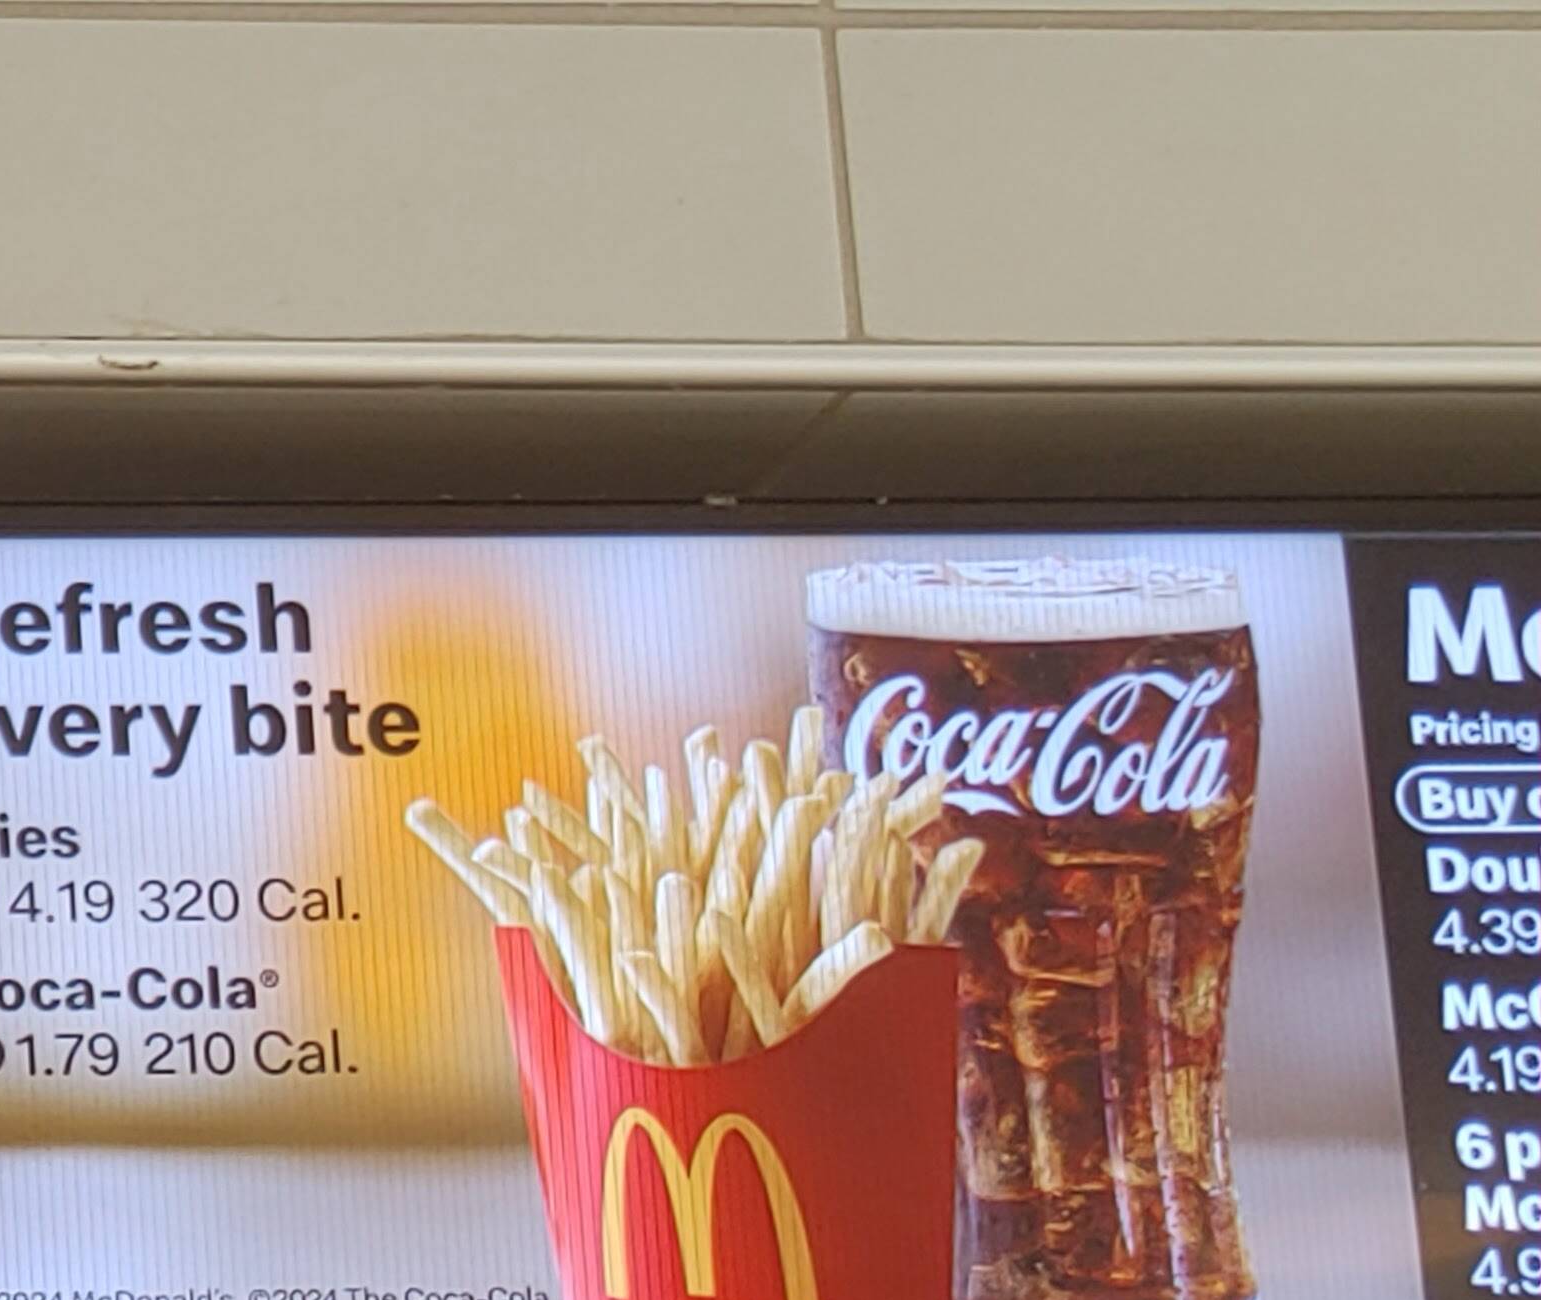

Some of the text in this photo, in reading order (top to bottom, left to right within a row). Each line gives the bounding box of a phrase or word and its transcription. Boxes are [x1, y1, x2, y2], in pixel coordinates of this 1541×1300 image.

[229, 679, 422, 758] bite
[843, 667, 1236, 818] Coca-Cola
[1409, 710, 1540, 752] Pricing
[1417, 777, 1517, 828] Buy
[1425, 845, 1541, 894] Dou
[8, 878, 116, 925] 4.19
[138, 877, 241, 924] 320
[257, 875, 362, 923] Cal.
[1432, 907, 1541, 956] 4.39
[15, 1031, 120, 1078] 1.79
[143, 1030, 237, 1077] 210
[252, 1027, 360, 1076] Cal.
[1447, 1045, 1541, 1093] 4.19
[1454, 1121, 1497, 1171] 6
[1469, 1246, 1541, 1296] 4.9
